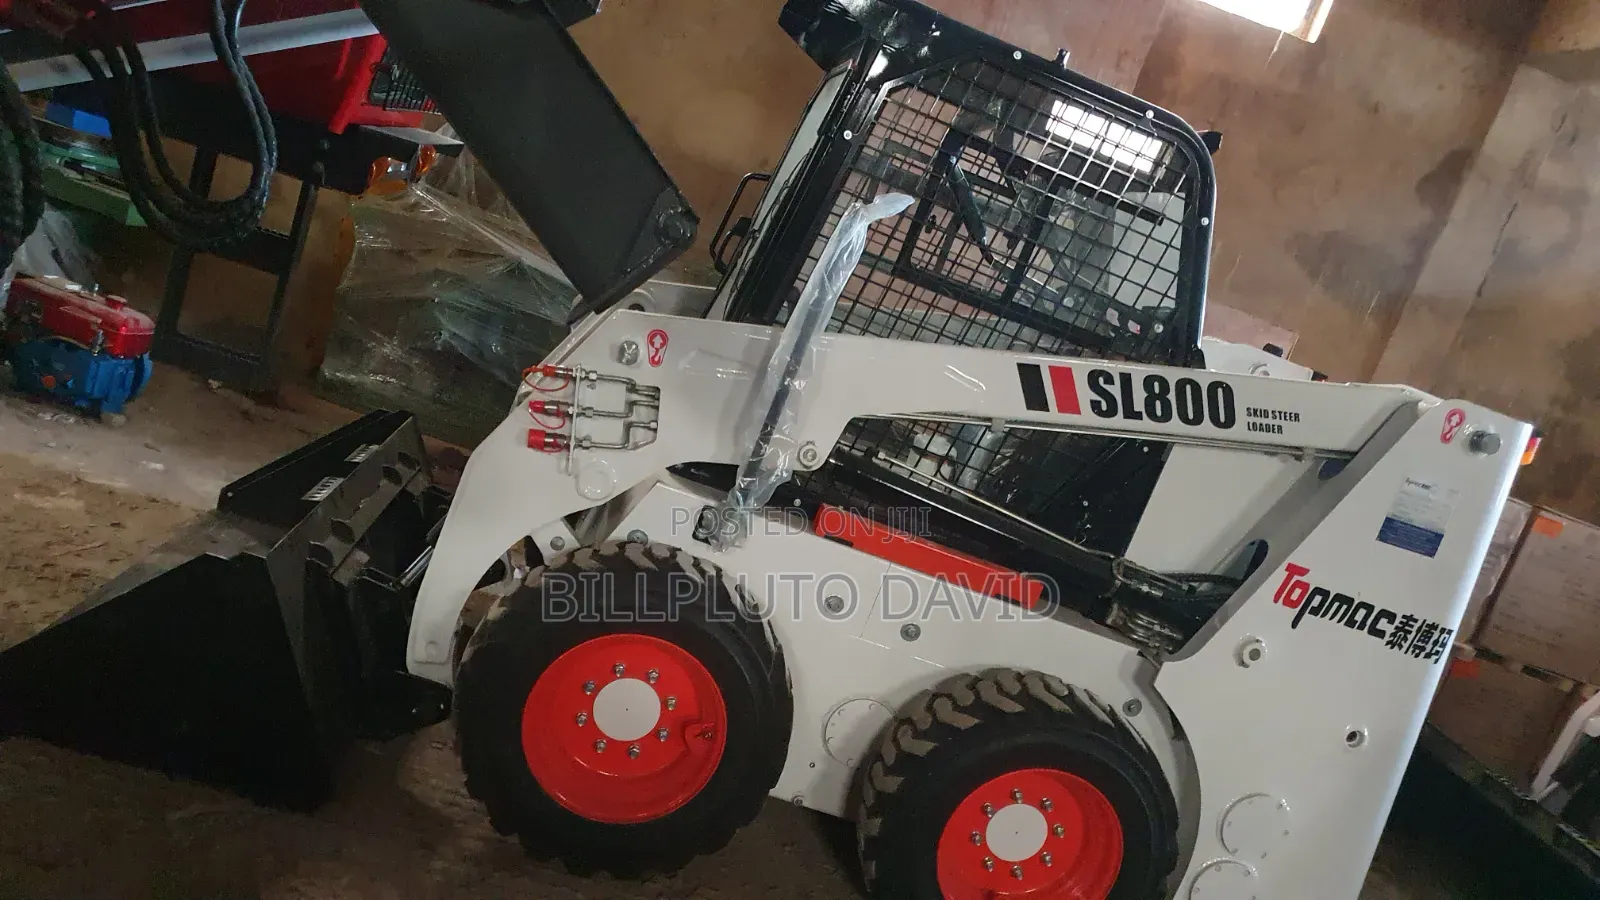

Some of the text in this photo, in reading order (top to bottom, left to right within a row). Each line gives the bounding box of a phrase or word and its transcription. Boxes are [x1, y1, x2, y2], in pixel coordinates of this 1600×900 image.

[1087, 369, 1236, 429] SL800
[1246, 407, 1300, 422] SKID STEER
[1247, 421, 1283, 434] LOADER
[1273, 563, 1397, 640] Topmac
